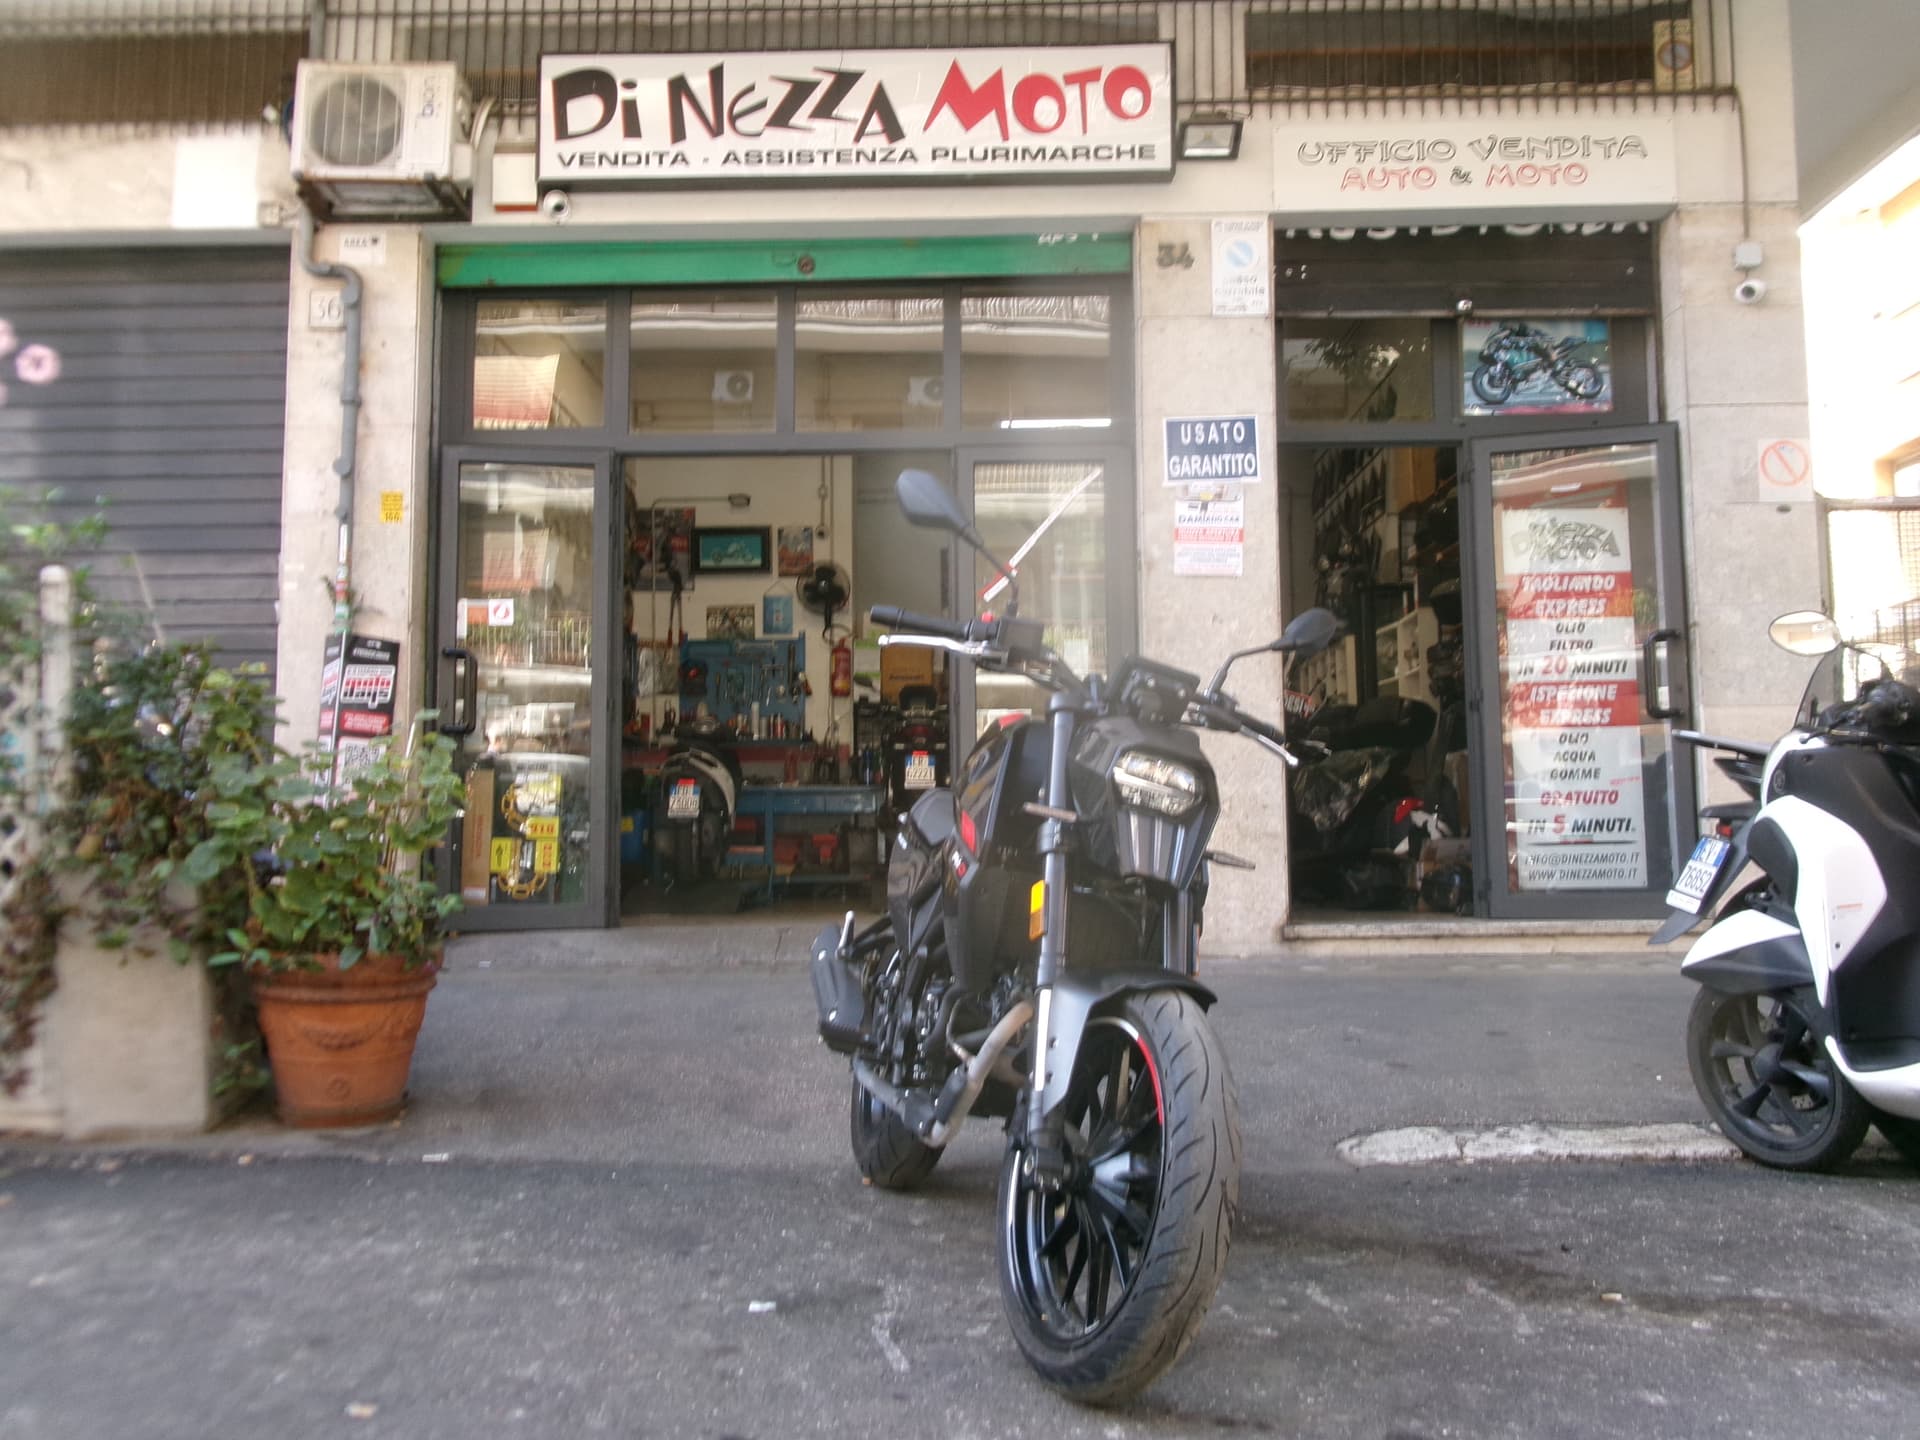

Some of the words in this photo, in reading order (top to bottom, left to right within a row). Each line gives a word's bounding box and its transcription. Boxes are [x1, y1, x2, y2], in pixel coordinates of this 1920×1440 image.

[557, 150, 690, 168] VENDITA
[721, 147, 918, 167] ASSISTENZA
[931, 144, 1156, 163] PLURIMARCHE
[1297, 138, 1458, 166] UFFICIO
[1466, 133, 1648, 163] VENDITA
[1340, 164, 1437, 192] AUTO
[1449, 166, 1473, 187] &
[1484, 162, 1589, 189] MOTO
[1156, 242, 1195, 270] 34
[1180, 420, 1247, 446] USATO
[1167, 450, 1257, 479] GARANTITO
[1520, 574, 1616, 593] TAGLIANDO
[1535, 597, 1608, 617] EXPRESS
[1556, 622, 1586, 634] OLIO
[1549, 639, 1594, 652] FILTRO
[1541, 654, 1568, 675] 20
[1571, 659, 1628, 676] MINUTI
[1530, 683, 1618, 702] ISPEZIONE
[1558, 731, 1589, 745] OLIO
[1553, 749, 1596, 762] ACQUA
[1550, 767, 1602, 781] GOMME
[1540, 790, 1620, 806] GRATUITO
[1527, 819, 1547, 834] IN
[1552, 813, 1567, 834] 5
[1528, 867, 1638, 882] WWW.DINEZZAMOTO.IT
